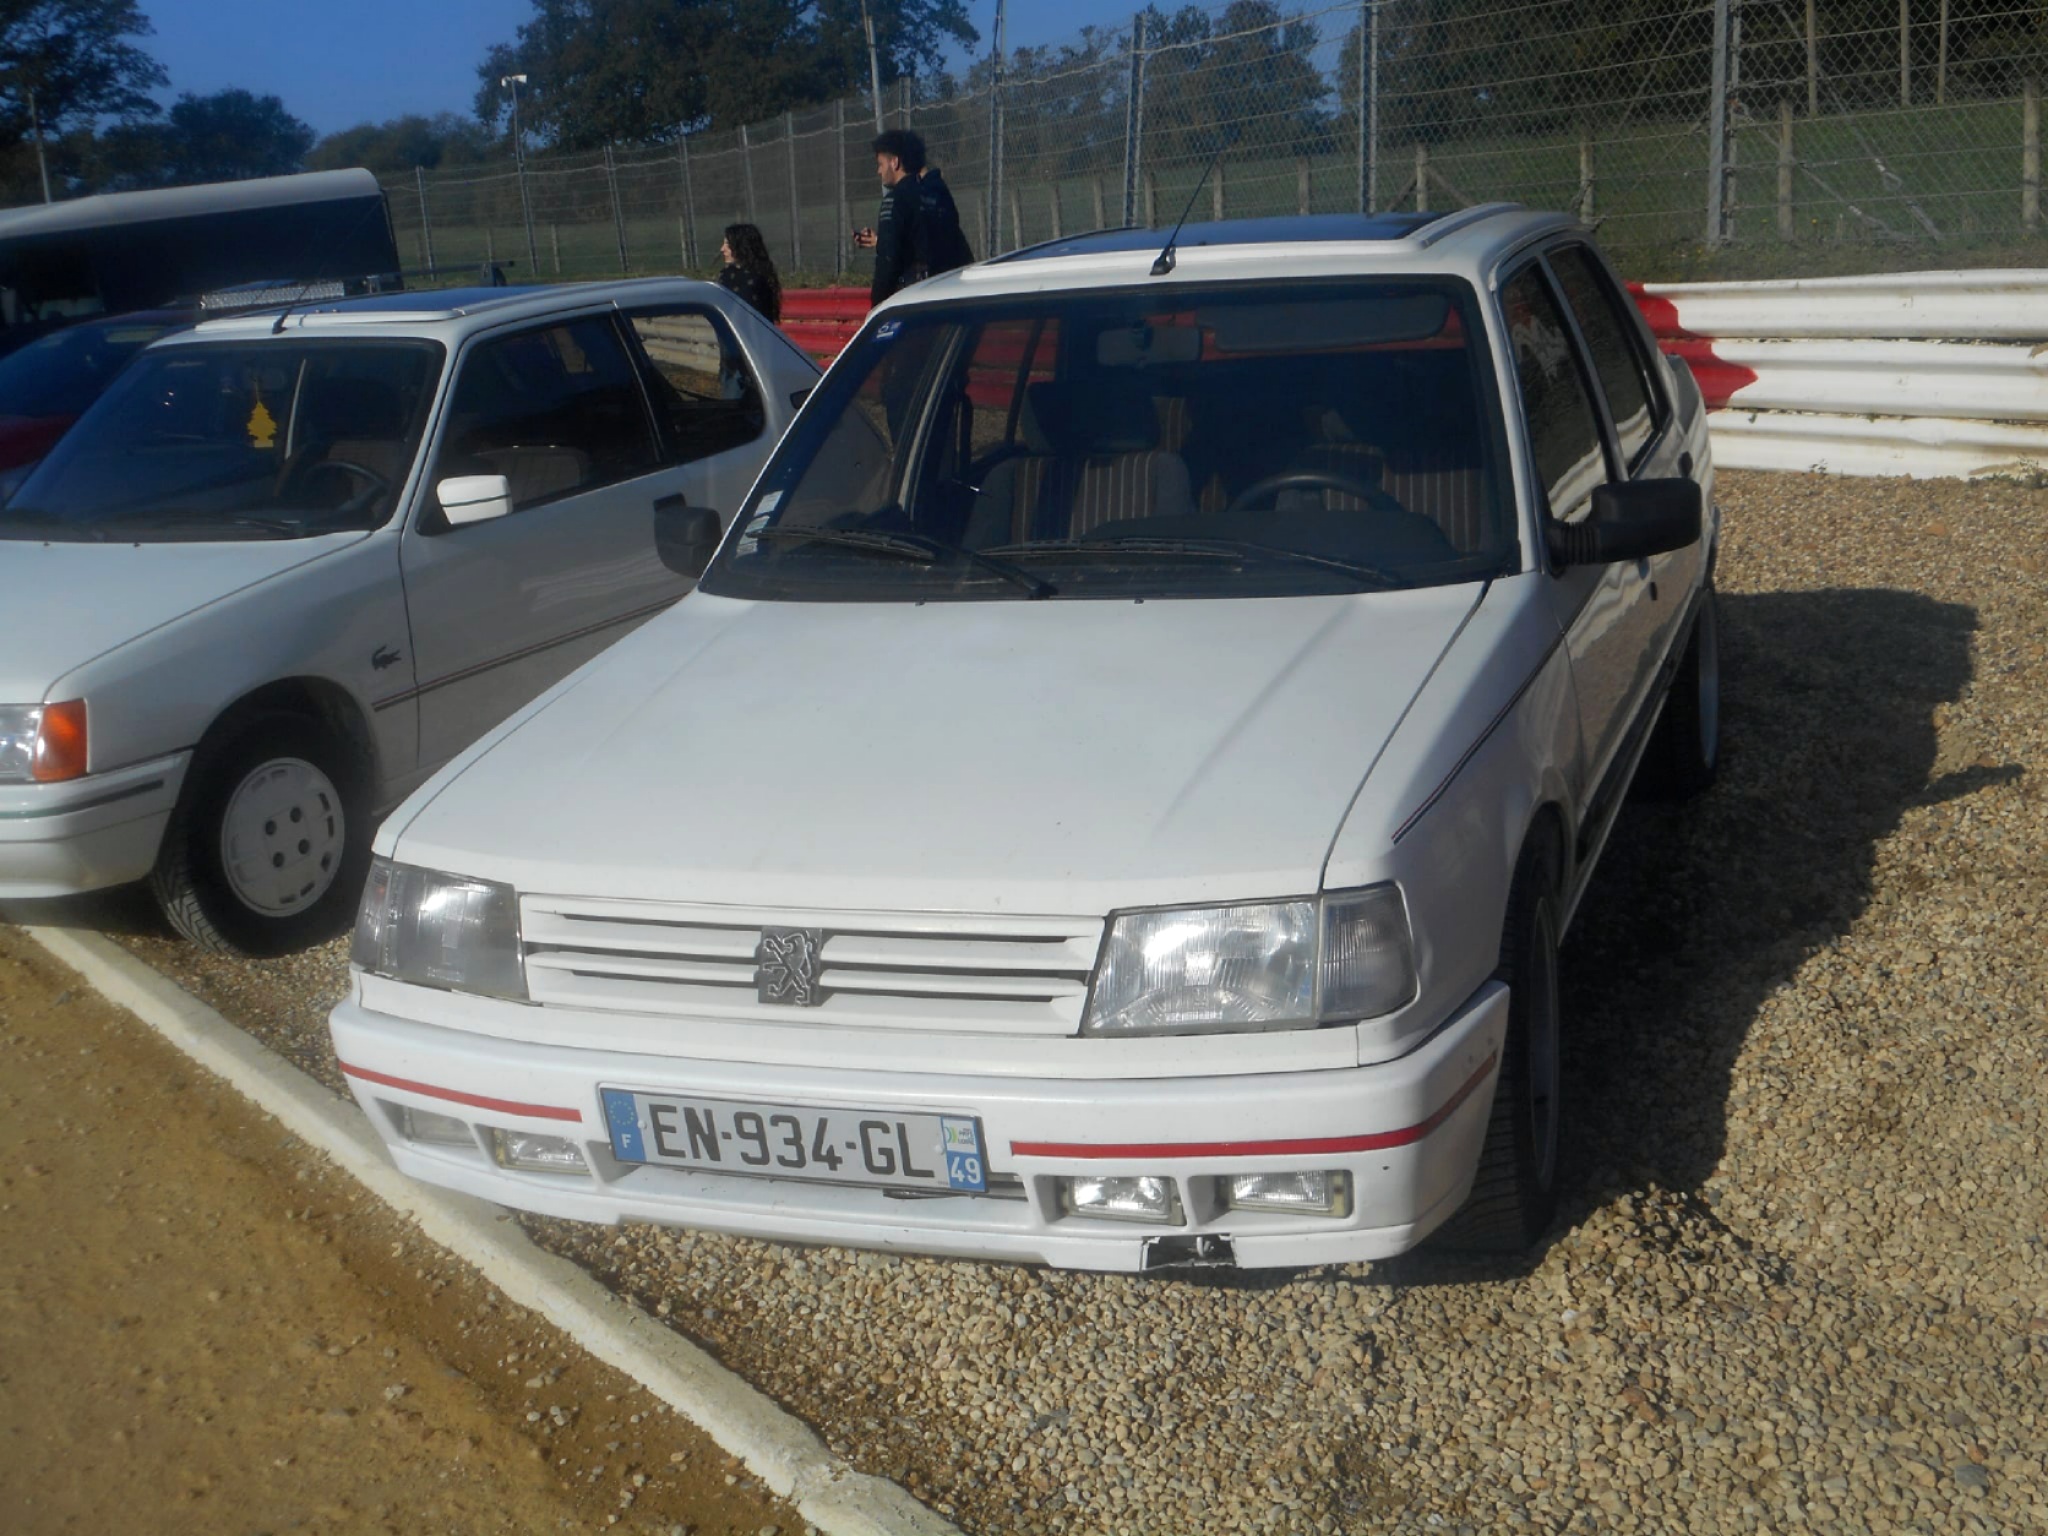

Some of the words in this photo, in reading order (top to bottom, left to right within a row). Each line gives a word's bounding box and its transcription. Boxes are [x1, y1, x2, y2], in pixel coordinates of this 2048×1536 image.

[621, 1133, 631, 1149] F
[649, 1104, 935, 1178] EN-934-GL
[951, 1156, 981, 1184] 49
